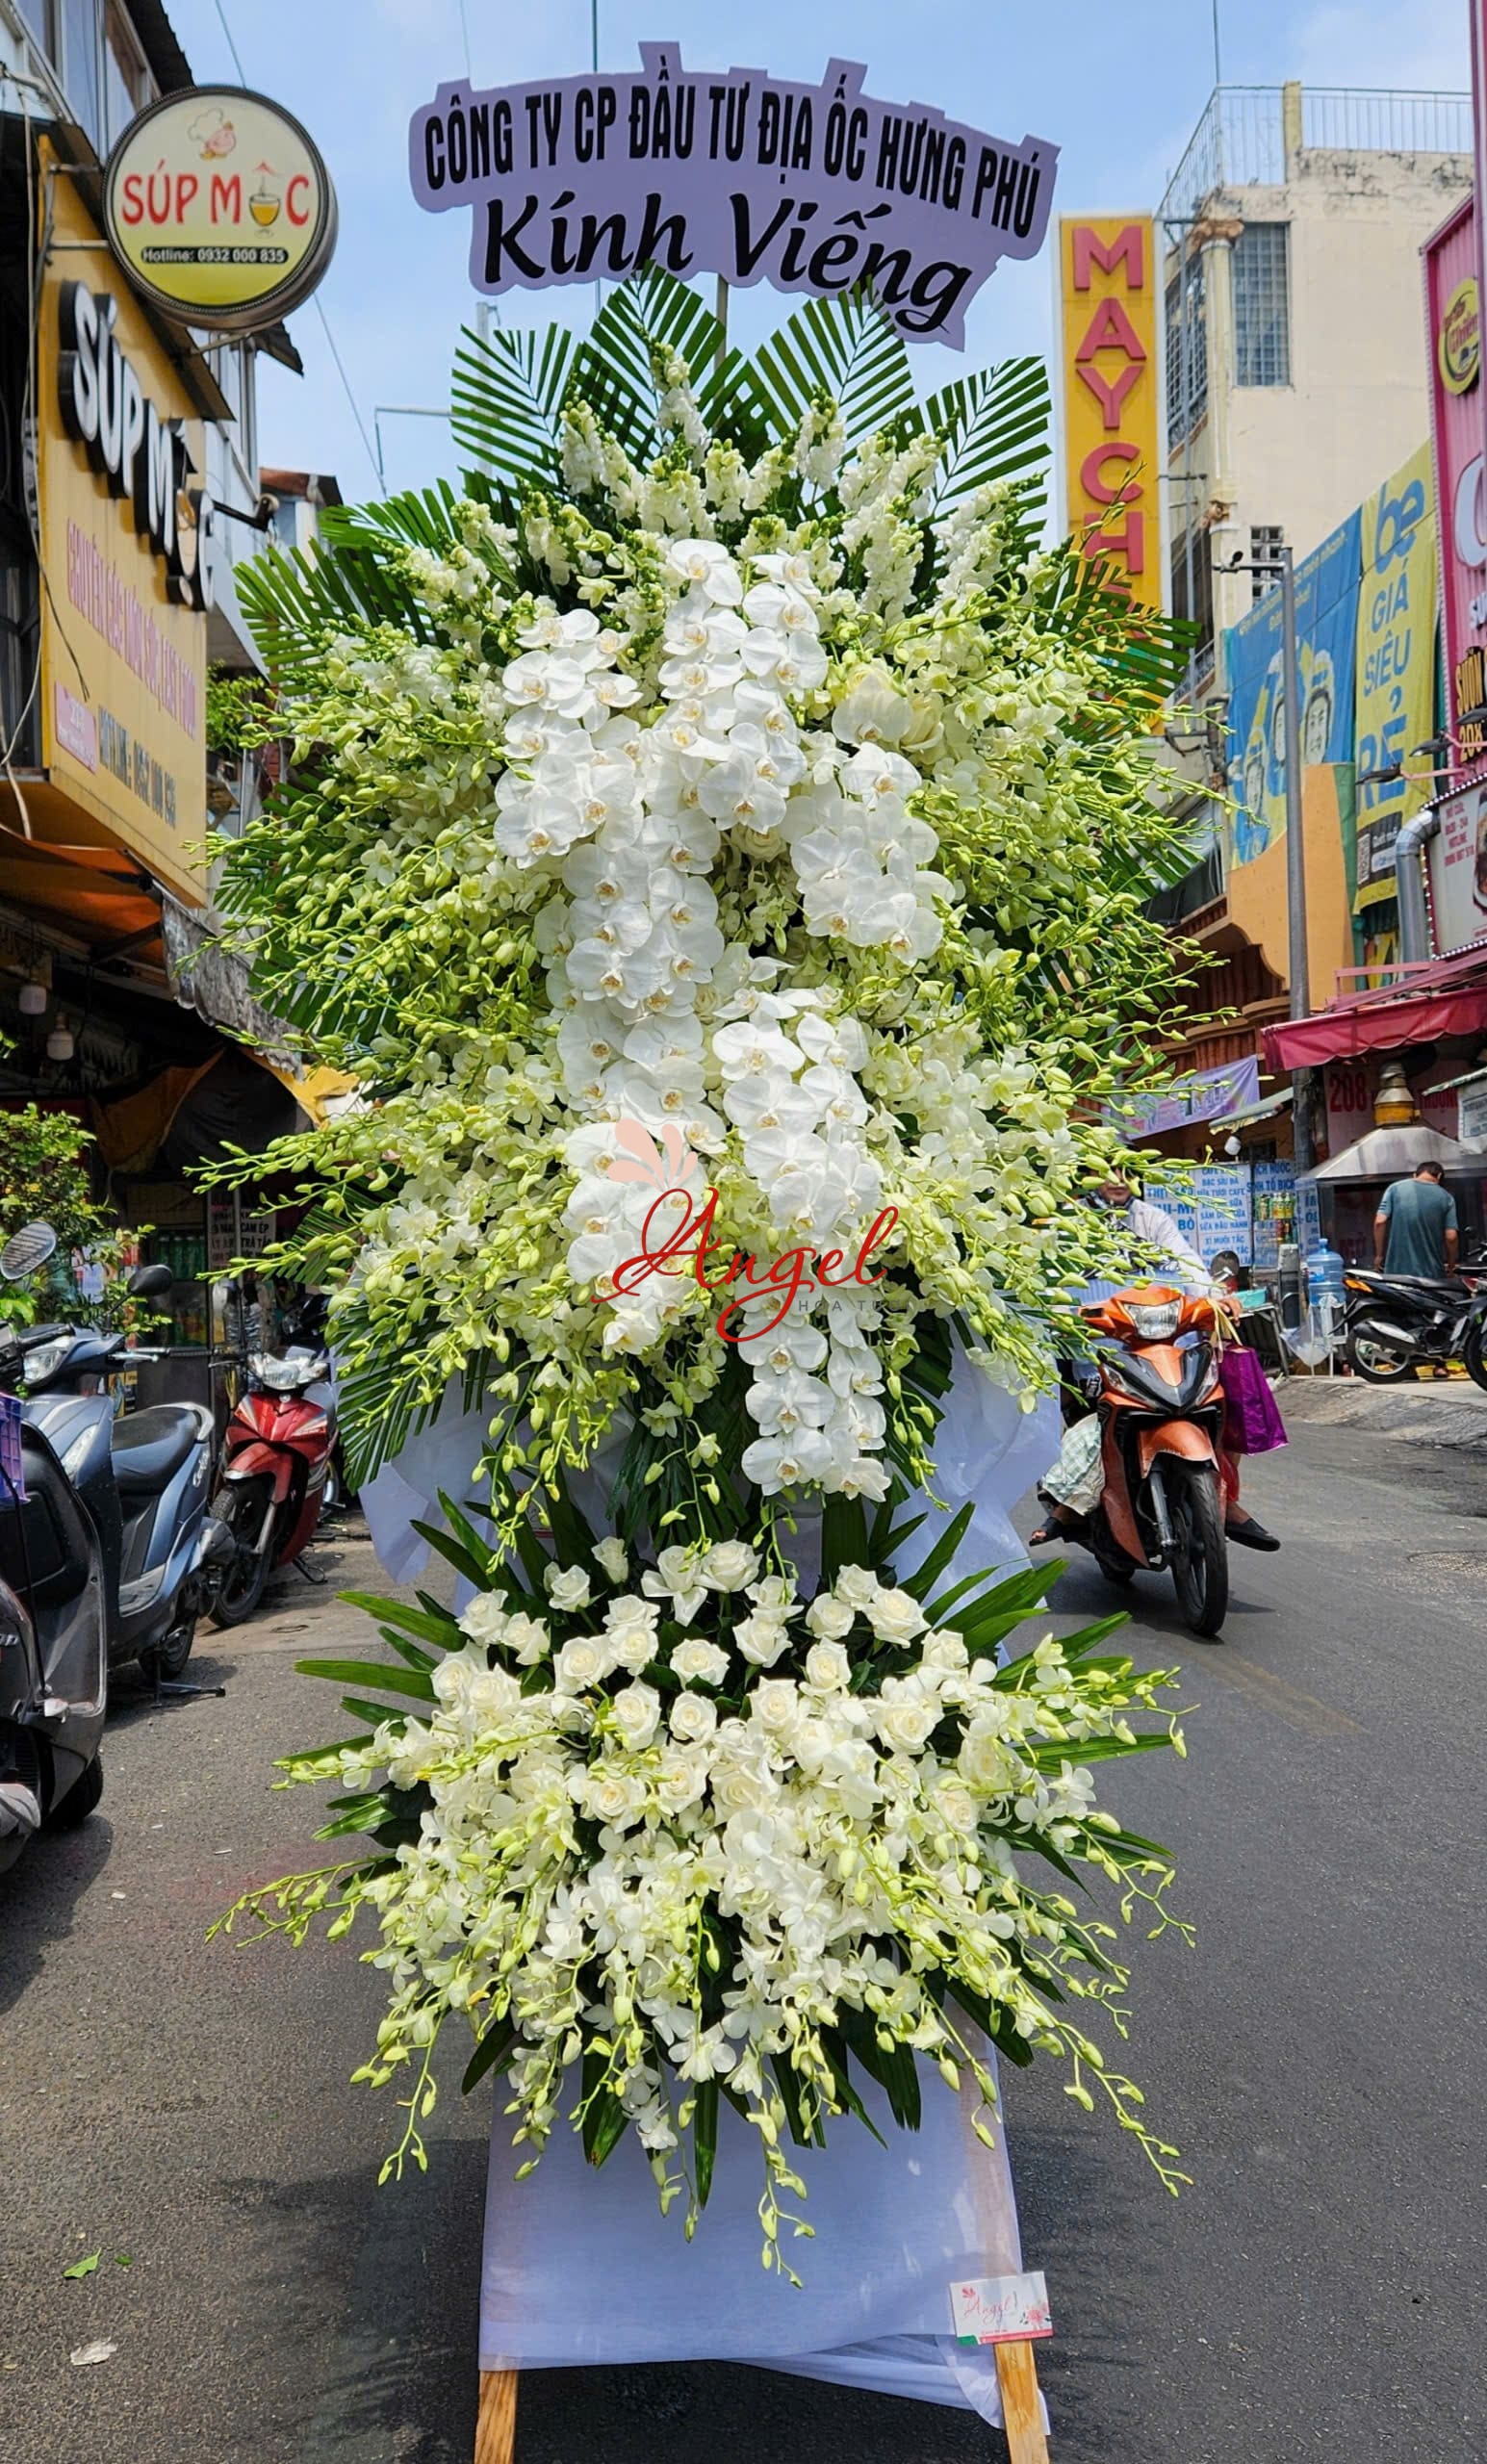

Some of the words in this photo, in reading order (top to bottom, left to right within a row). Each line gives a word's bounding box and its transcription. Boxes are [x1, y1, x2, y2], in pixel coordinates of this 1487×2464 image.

[121, 159, 198, 224] SÚP
[423, 96, 514, 191] CÔNG
[526, 92, 563, 168] TY
[576, 87, 617, 163] CP
[628, 54, 694, 160] ĐẦU
[708, 83, 751, 161] TƯ
[758, 90, 812, 184] ĐỊA
[824, 73, 869, 187] ỐC
[877, 114, 965, 210] HƯNG
[972, 149, 1042, 239] PHÚ
[144, 248, 192, 262] Hotline:
[197, 248, 230, 262] 0932
[233, 248, 257, 262] 000
[260, 248, 285, 262] 835
[485, 191, 695, 285] Kính
[730, 192, 973, 334] Viếng
[69, 281, 144, 499] SÚP
[1374, 479, 1425, 575] be
[1372, 556, 1409, 634] GIÁ
[1364, 629, 1411, 698] SIÊU
[1354, 685, 1408, 816] RẺ
